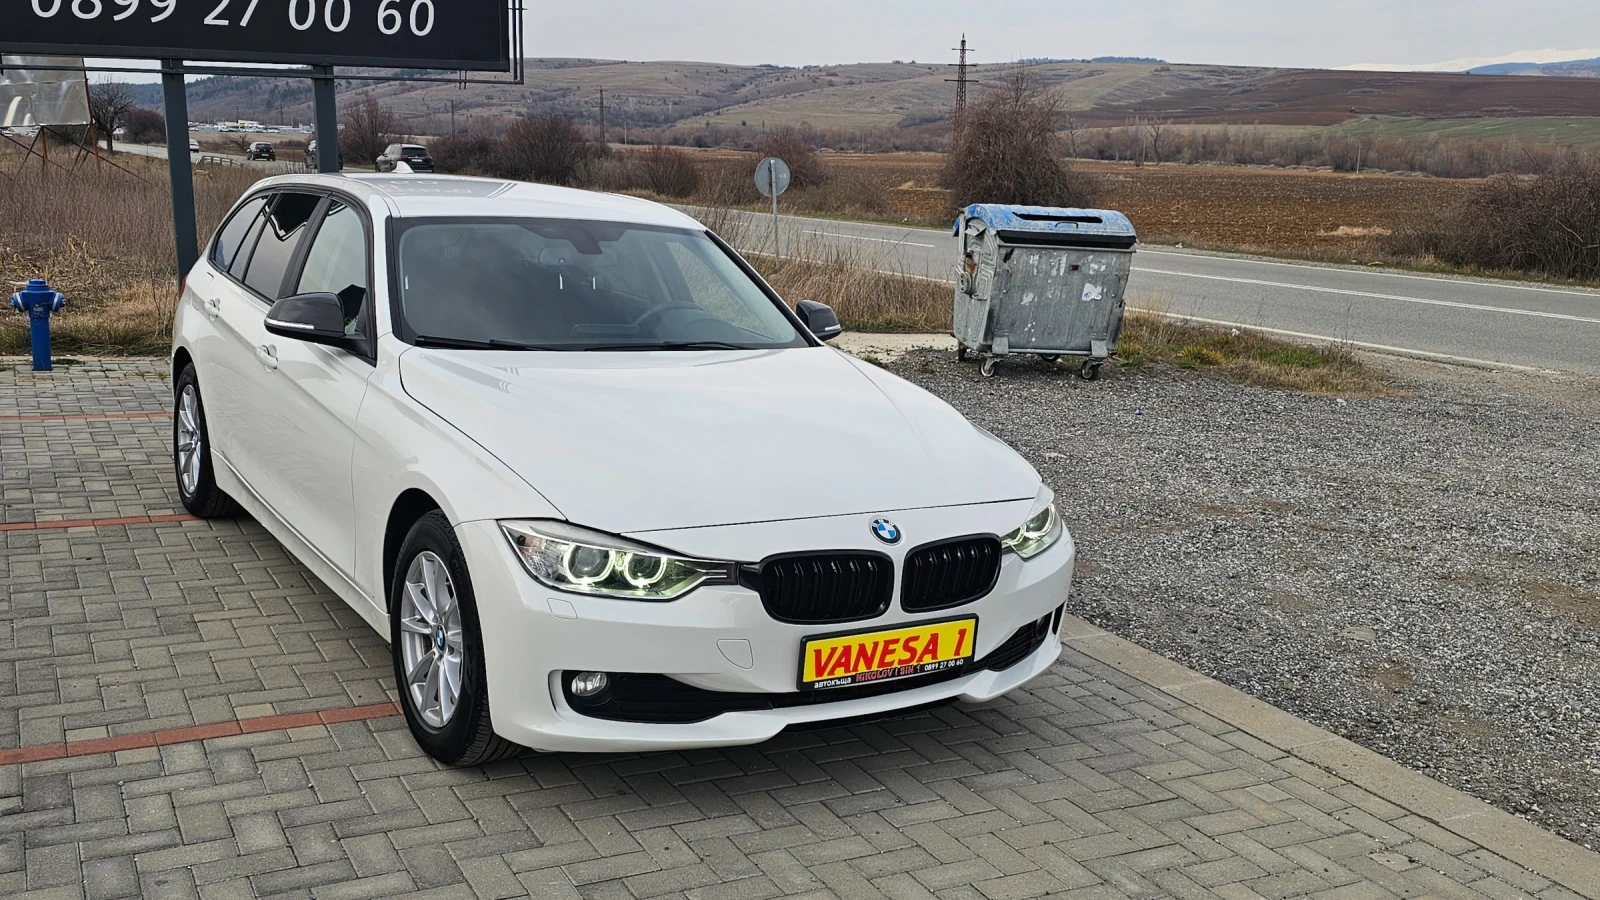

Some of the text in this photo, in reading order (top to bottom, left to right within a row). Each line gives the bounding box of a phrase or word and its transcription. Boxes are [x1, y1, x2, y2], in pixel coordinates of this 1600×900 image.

[203, 0, 259, 27] 27
[288, 0, 351, 33] 00
[377, 0, 435, 37] 60
[814, 628, 967, 678] VANESA 1
[814, 677, 851, 689] автокъща
[855, 668, 893, 682] NIKOLOV
[924, 663, 939, 671] 0899
[939, 661, 947, 669] 27
